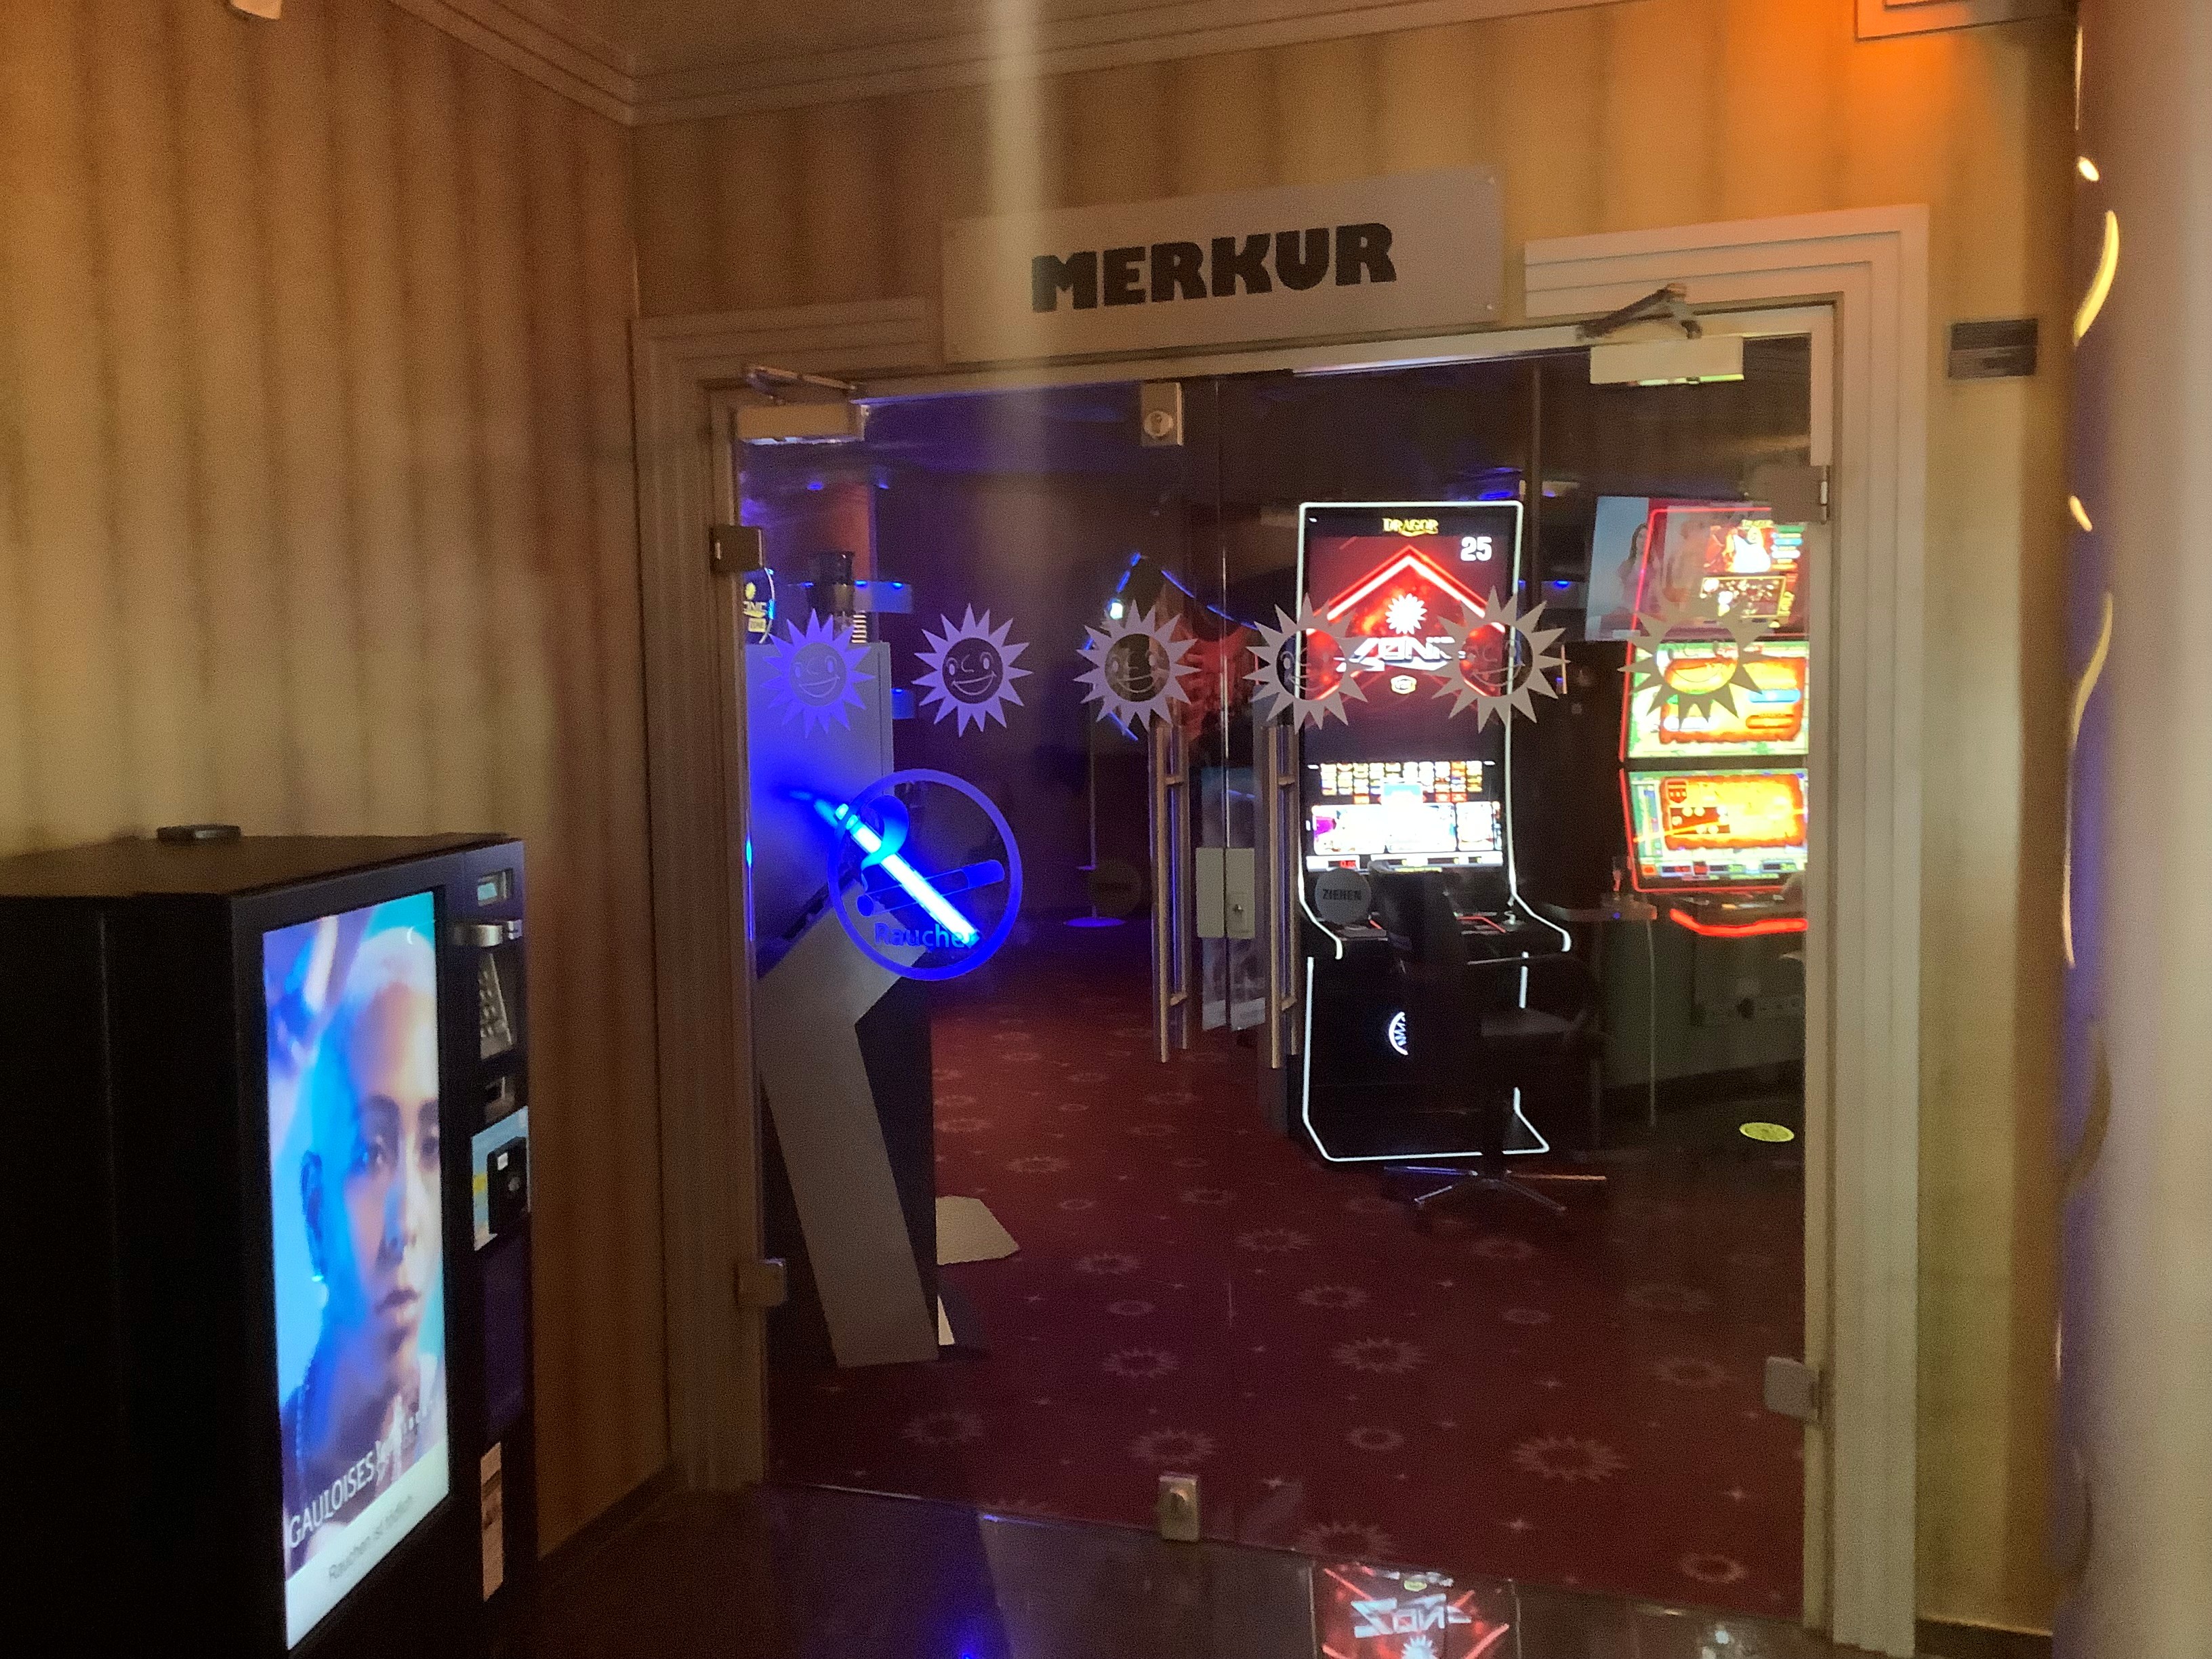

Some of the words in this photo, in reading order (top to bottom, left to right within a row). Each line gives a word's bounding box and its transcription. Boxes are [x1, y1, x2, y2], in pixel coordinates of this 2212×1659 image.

[1031, 222, 1397, 312] MERKUR
[1460, 535, 1493, 562] 25
[1322, 888, 1362, 901] ZIEHEN
[289, 1450, 374, 1549] GAULOISES
